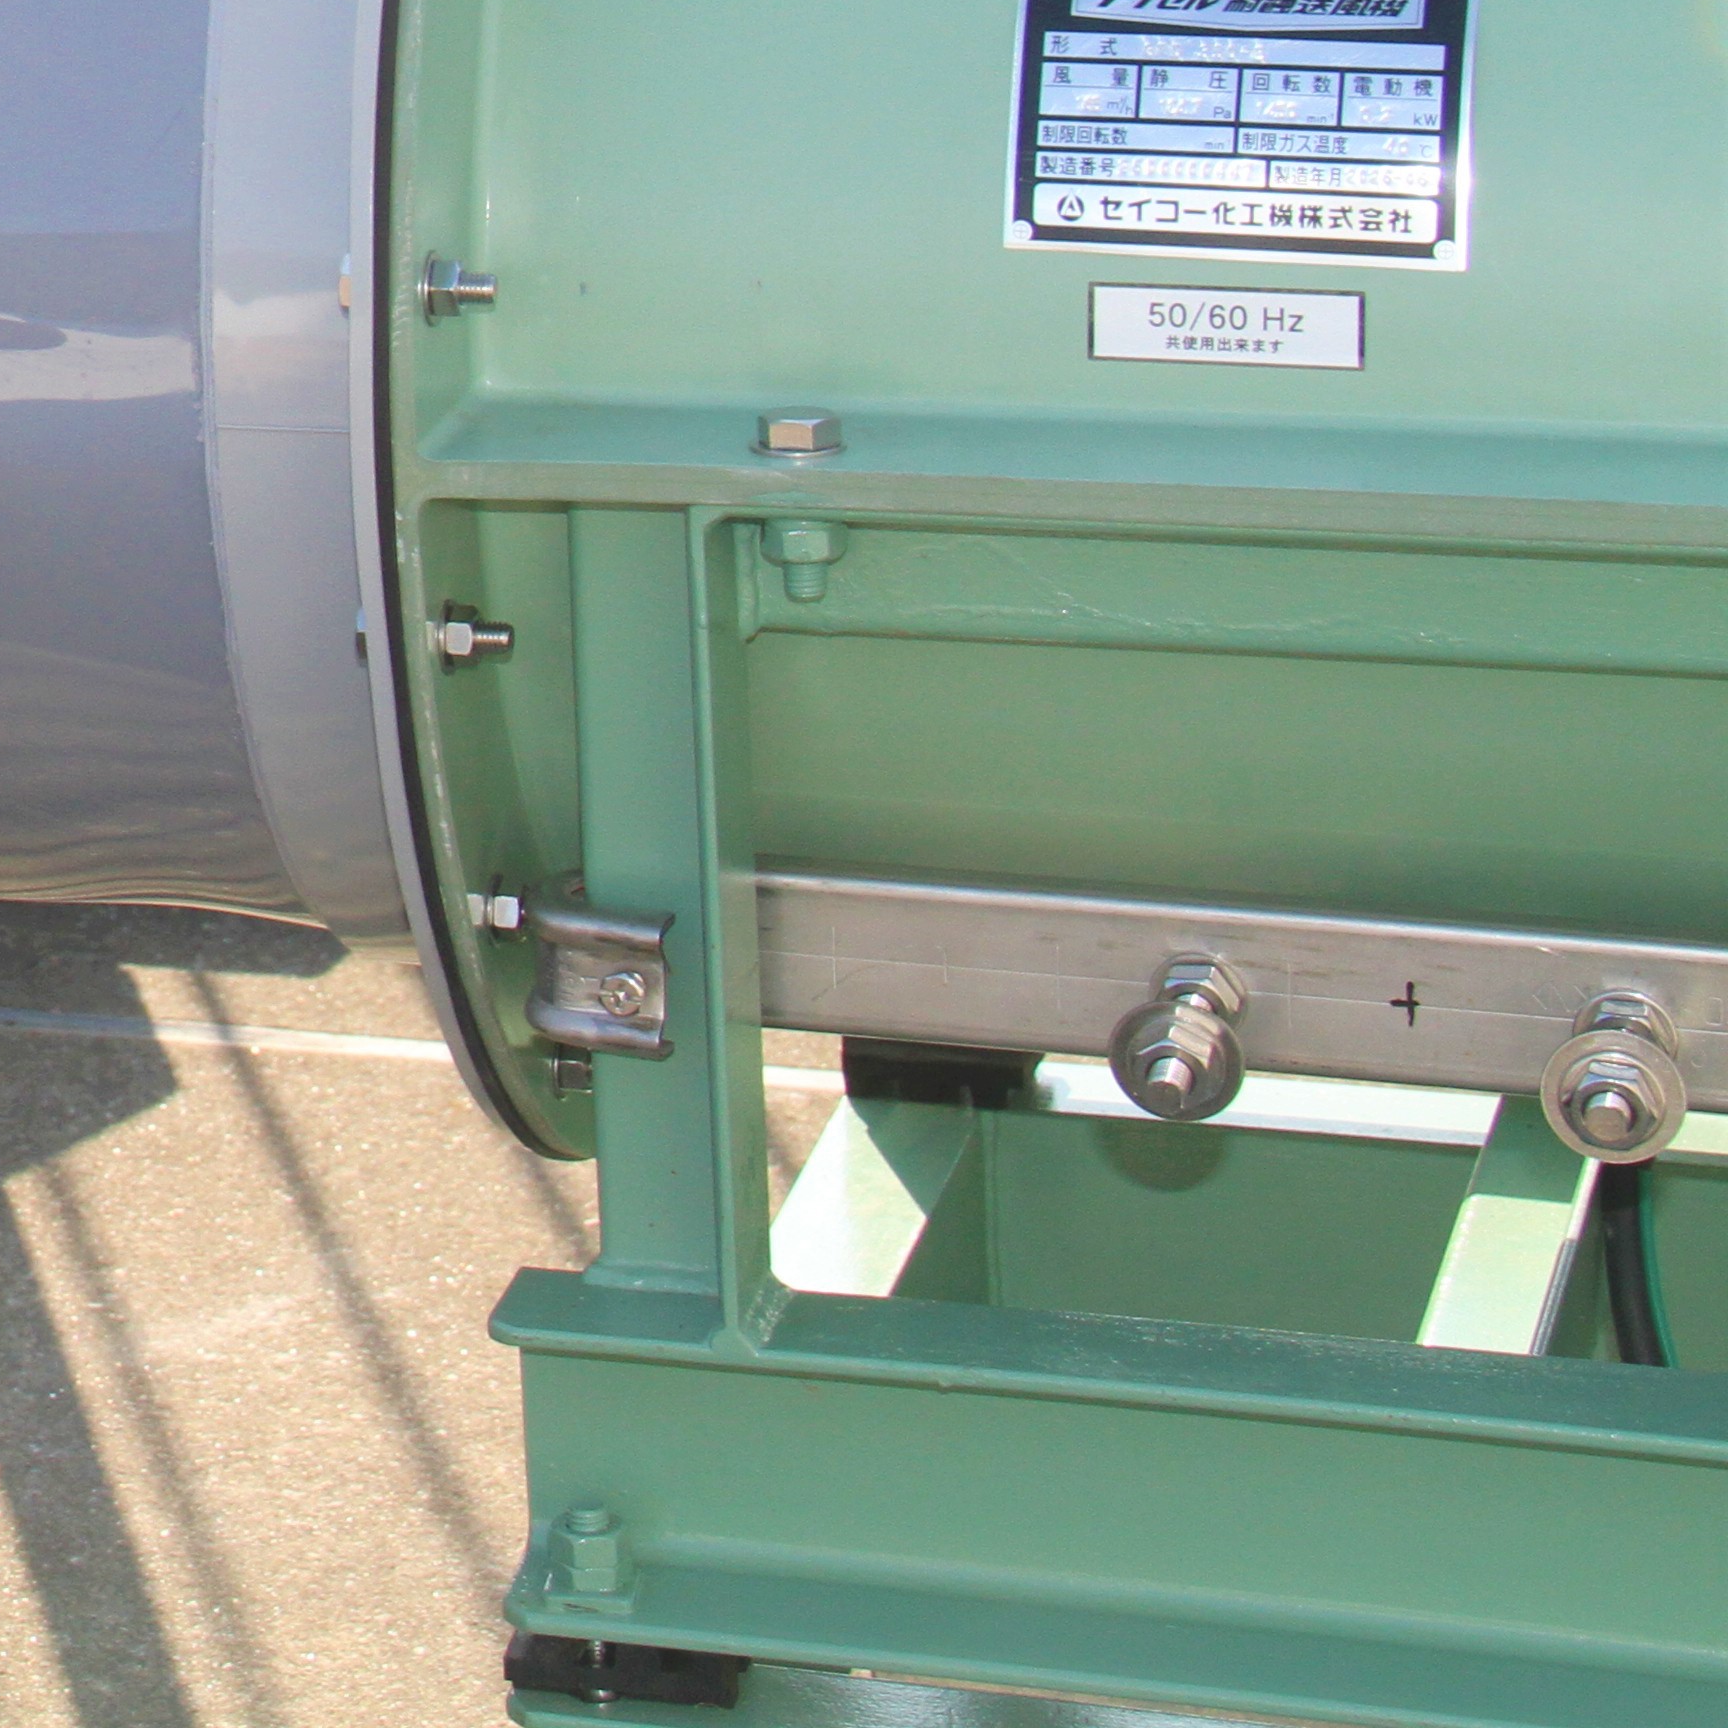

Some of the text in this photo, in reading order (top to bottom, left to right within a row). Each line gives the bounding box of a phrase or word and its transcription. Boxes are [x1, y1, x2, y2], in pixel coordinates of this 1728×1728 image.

[1252, 73, 1331, 93] 回転数
[1354, 76, 1434, 97] 電動機
[1213, 106, 1232, 119] Pa
[1413, 112, 1438, 126] kW
[1042, 125, 1128, 146] 制限回転数
[1242, 133, 1349, 155] 制限ガス温度
[1040, 155, 1115, 177] 製造番号
[1274, 165, 1342, 186] 製造年月
[1100, 195, 1412, 234] セイコー化工機株式会社
[1148, 301, 1305, 333] 50/60 Hz
